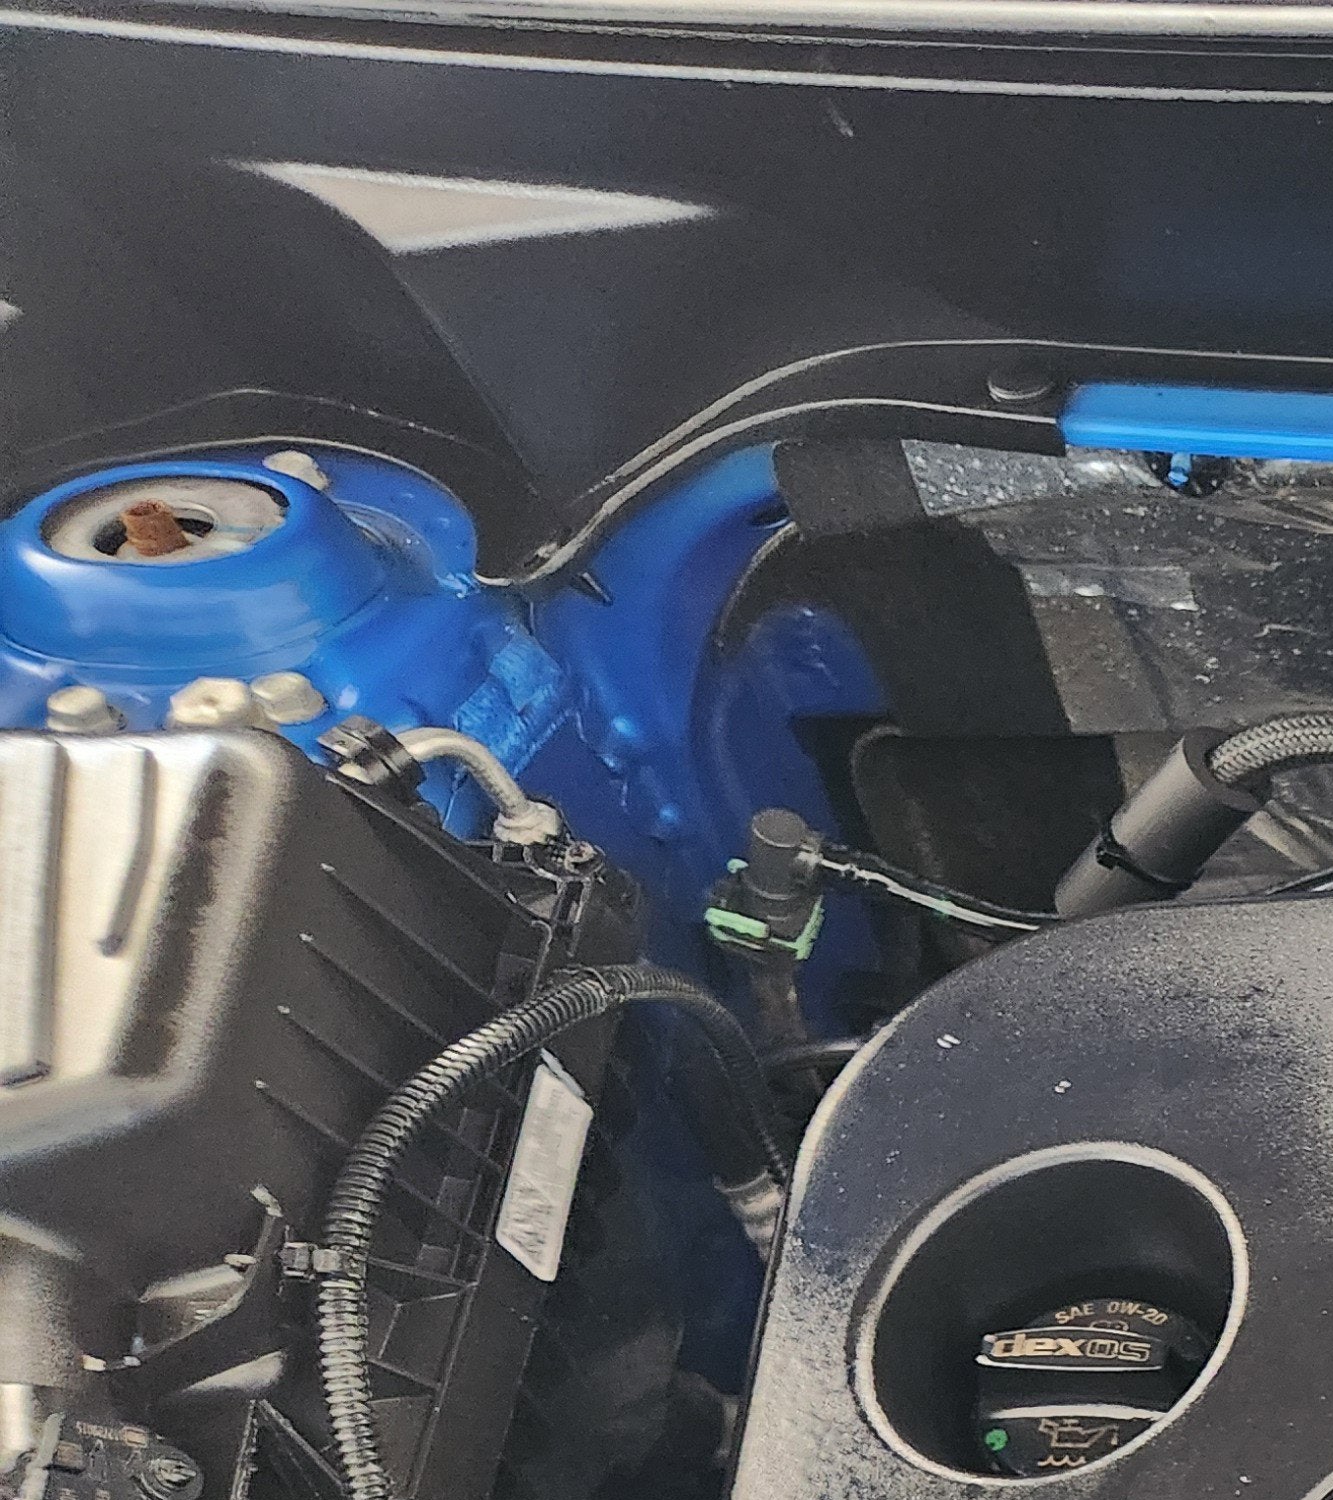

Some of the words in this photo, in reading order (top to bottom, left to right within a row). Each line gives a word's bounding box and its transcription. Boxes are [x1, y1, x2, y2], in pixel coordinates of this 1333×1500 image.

[1054, 1301, 1094, 1325] SAE
[1106, 1300, 1168, 1326] 0W-20
[991, 1335, 1151, 1362] dexos
